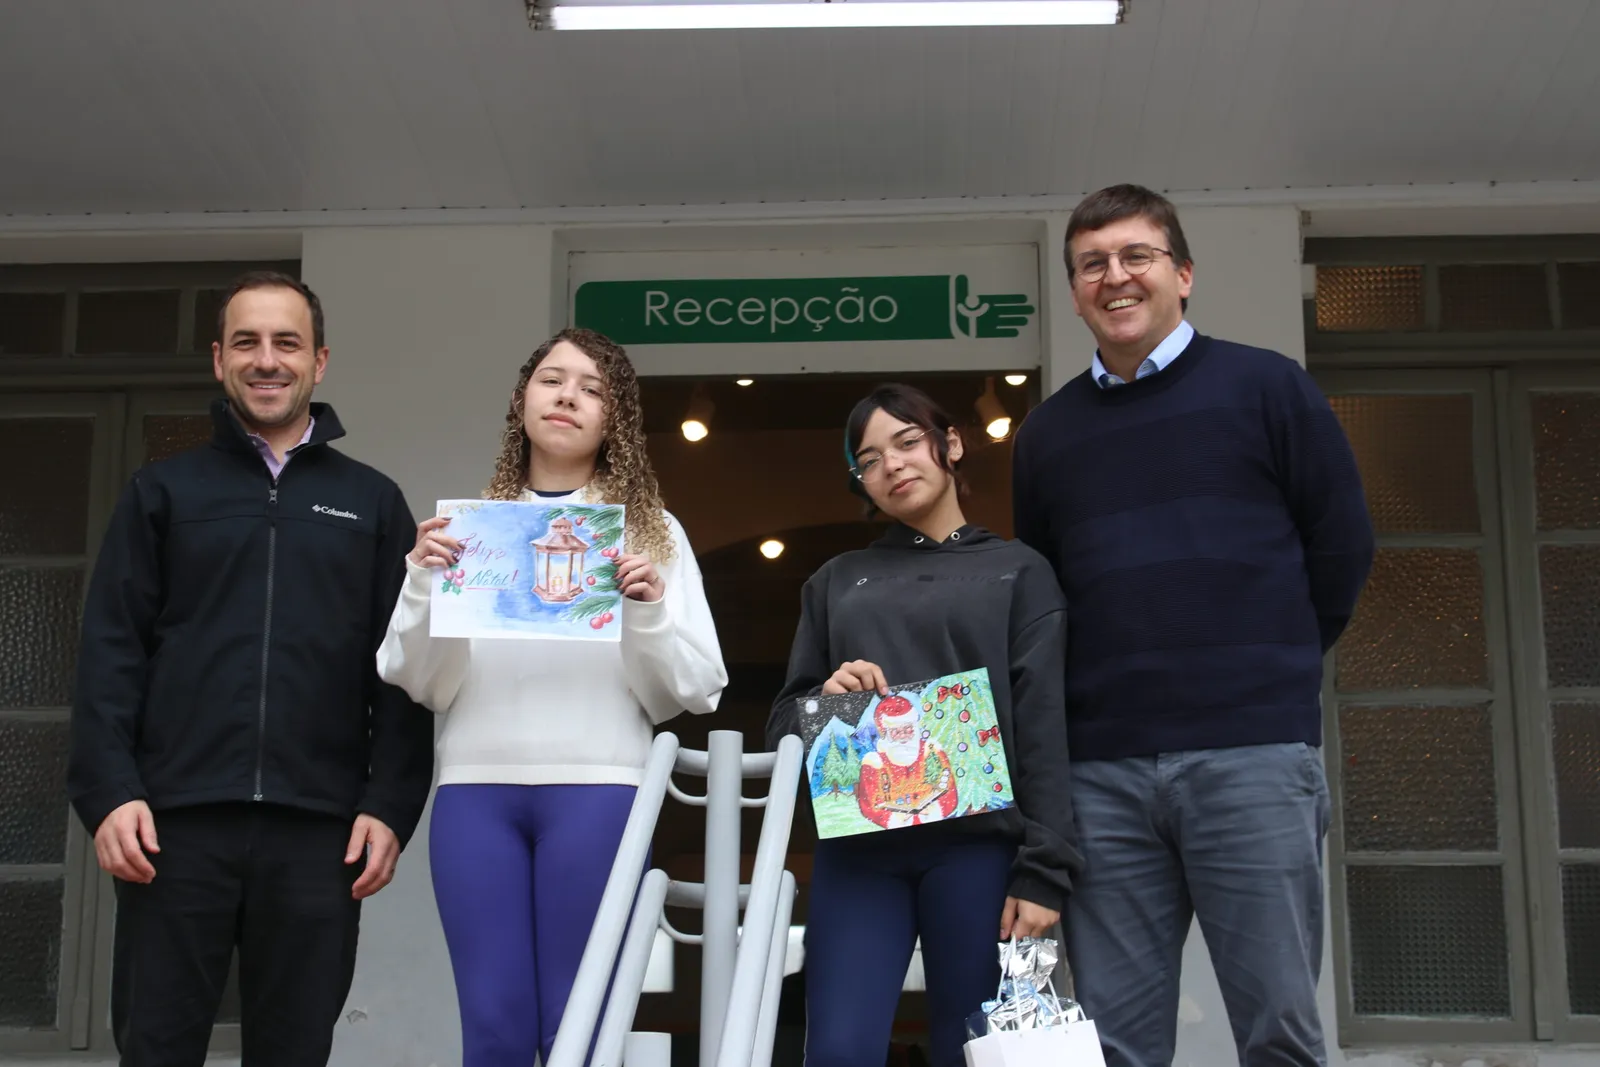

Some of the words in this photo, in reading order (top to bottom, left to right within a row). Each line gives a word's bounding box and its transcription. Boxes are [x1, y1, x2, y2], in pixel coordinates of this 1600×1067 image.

[644, 286, 899, 334] Recepção
[321, 505, 358, 520] Columbia
[453, 532, 506, 565] Feliz
[467, 569, 519, 587] Natal!
